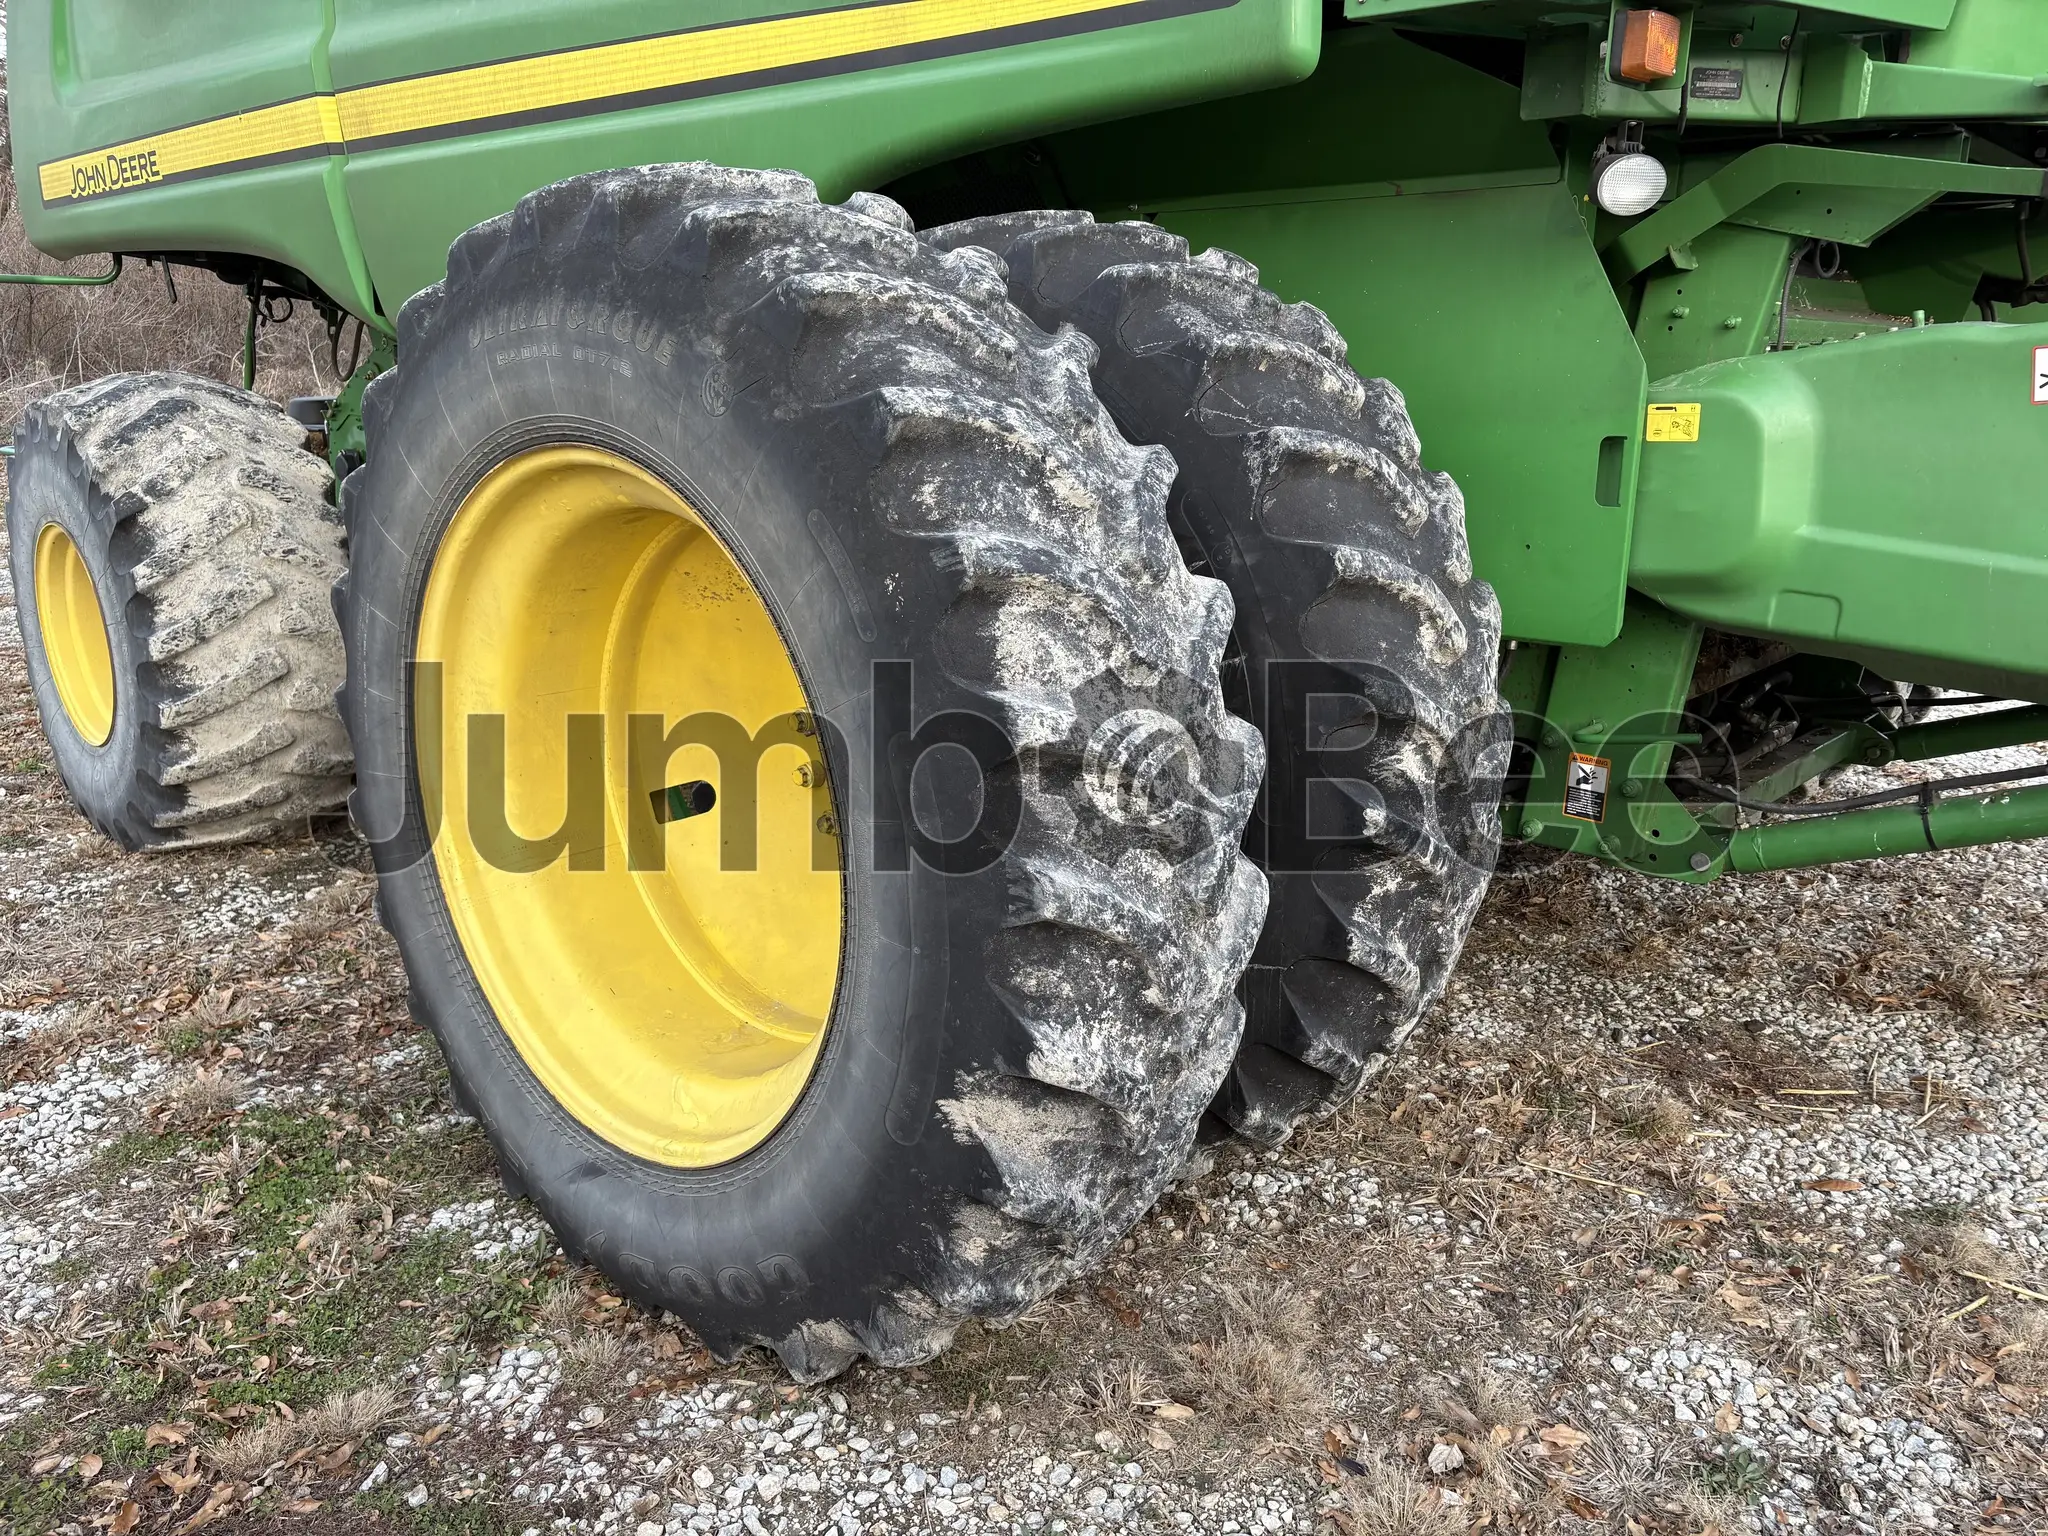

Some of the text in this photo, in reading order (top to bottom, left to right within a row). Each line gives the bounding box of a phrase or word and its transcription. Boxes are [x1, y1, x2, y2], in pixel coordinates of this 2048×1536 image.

[71, 150, 160, 194] JOHN DEERE
[497, 342, 562, 366] RADIAL
[1579, 755, 1608, 766] WARNING
